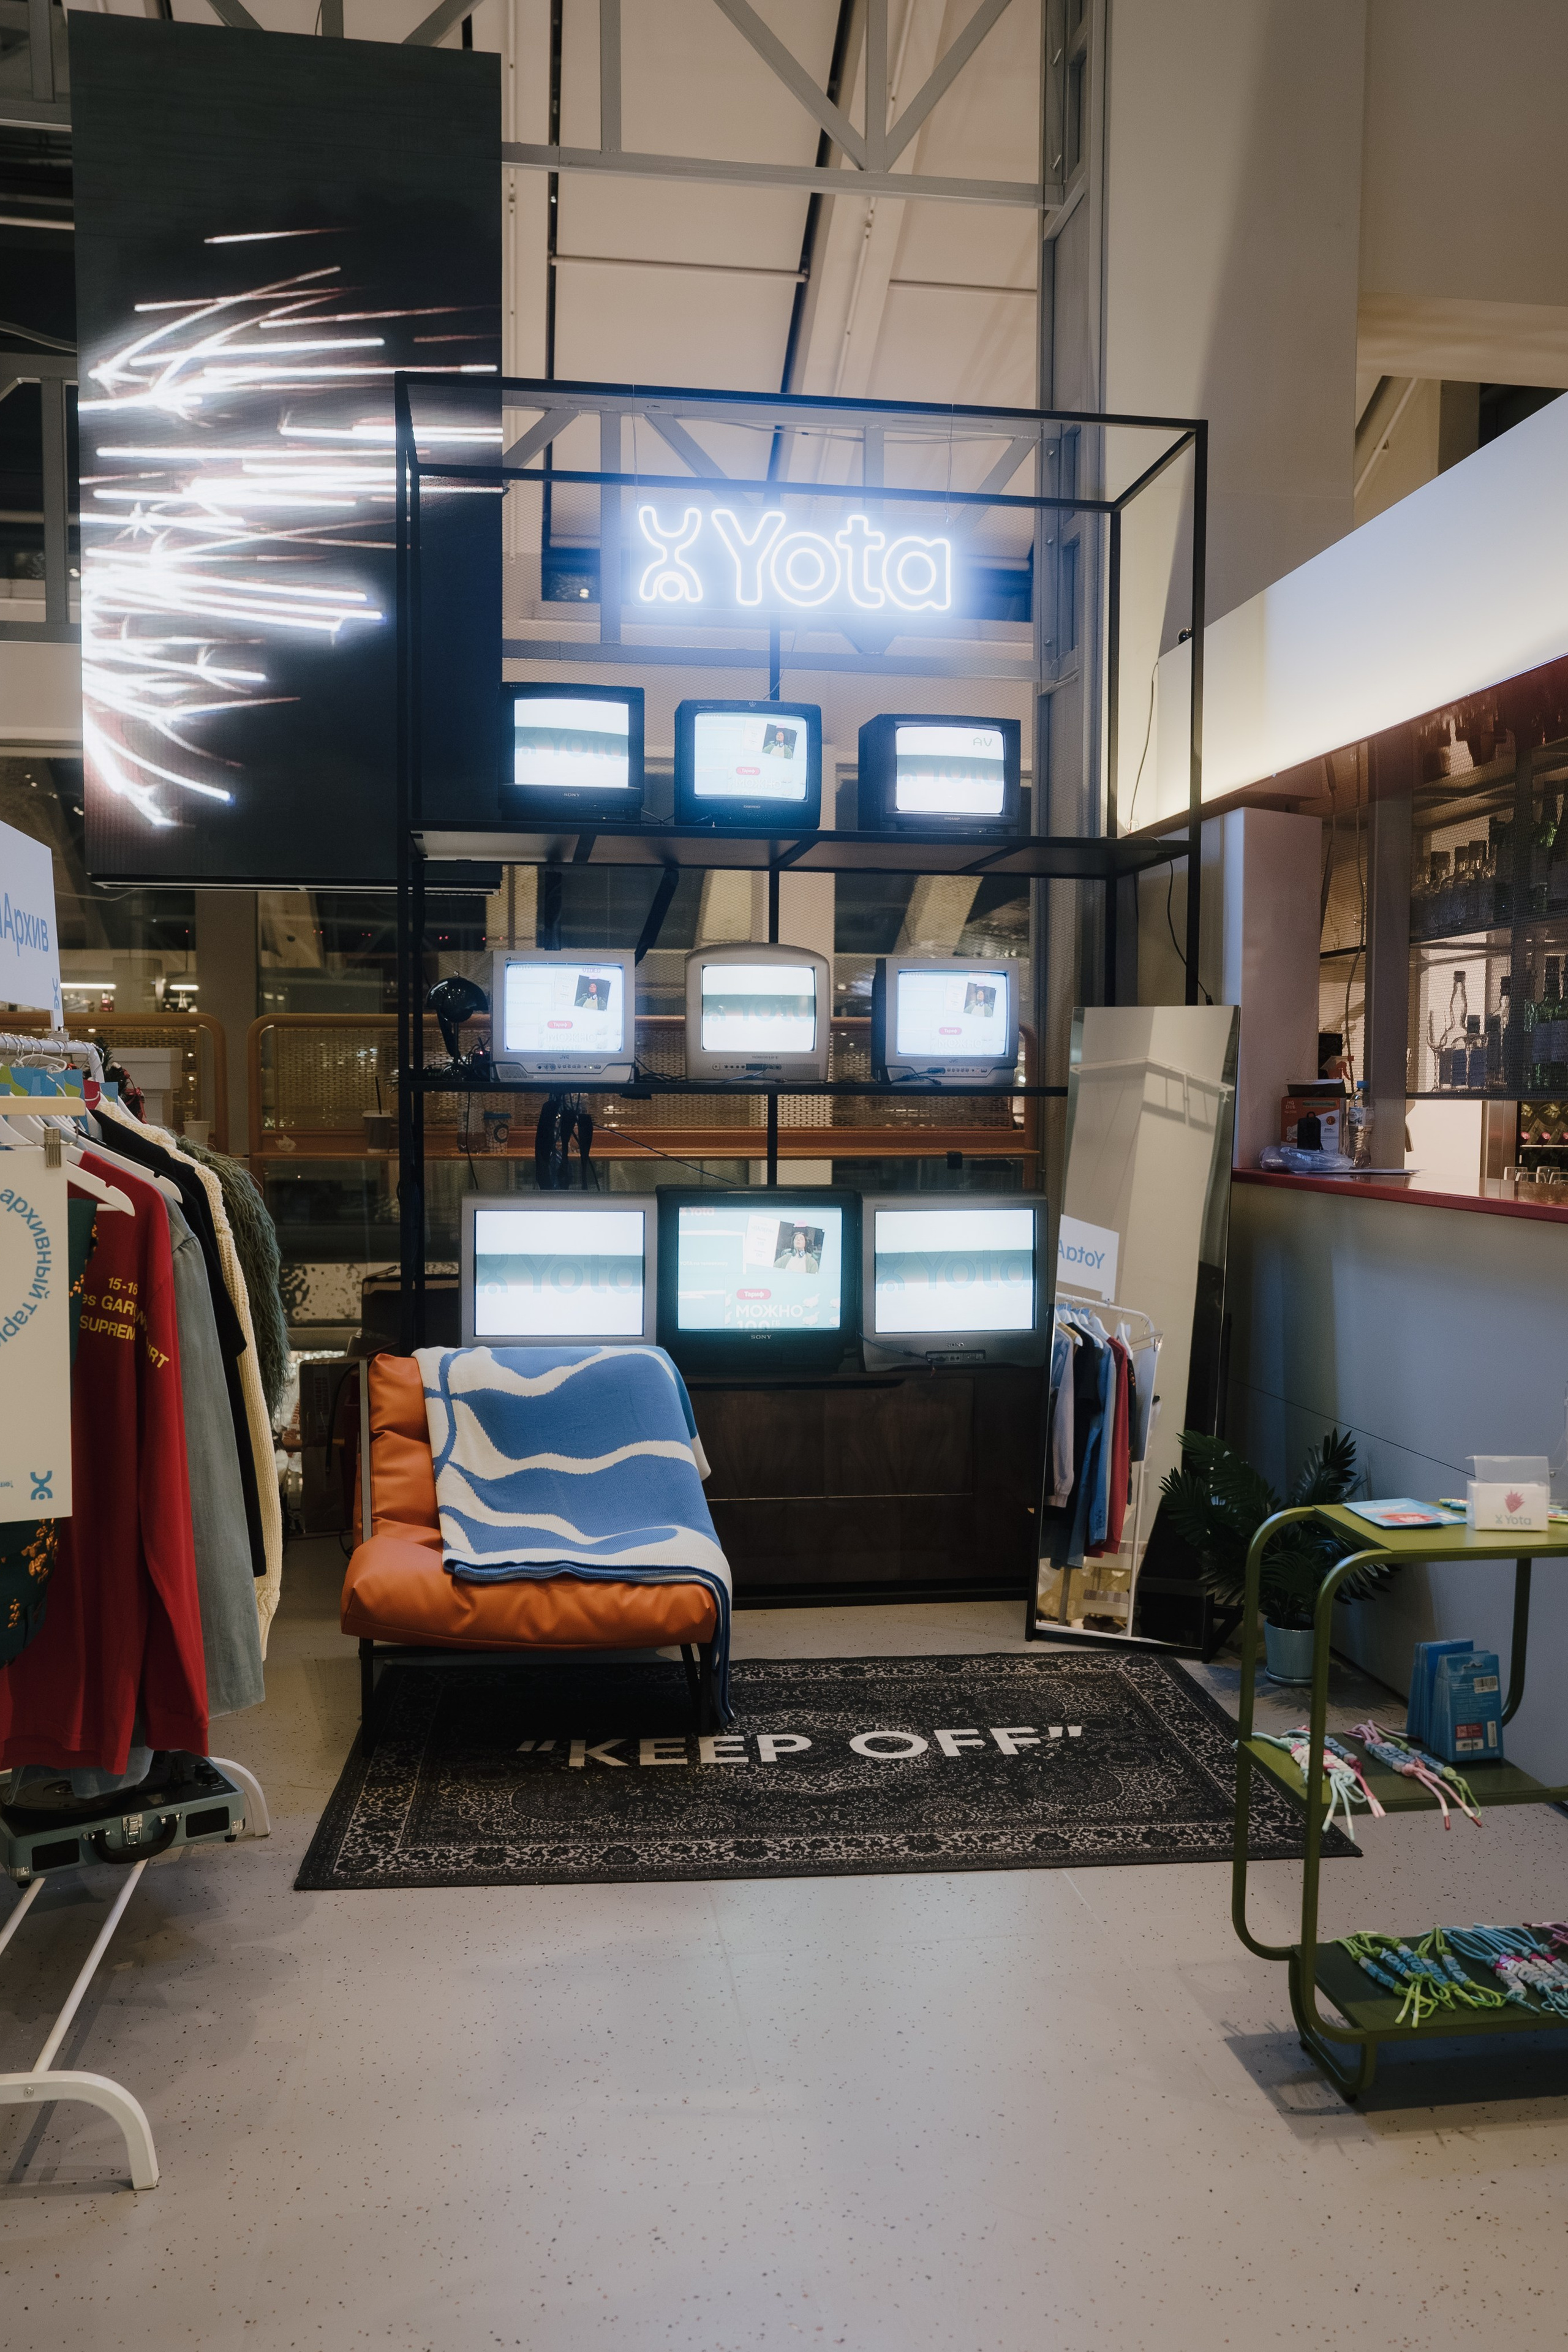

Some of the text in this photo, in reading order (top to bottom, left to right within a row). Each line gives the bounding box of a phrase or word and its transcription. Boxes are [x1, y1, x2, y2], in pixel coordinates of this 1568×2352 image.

[711, 508, 951, 611] Yota
[973, 737, 992, 747] AV
[736, 778, 782, 790] МОЖНО
[0, 892, 48, 956] Архив
[546, 1033, 597, 1043] МОЖНО
[938, 1038, 983, 1049] МОЖНО
[0, 1188, 51, 1299] архивный
[519, 1254, 641, 1294] Yota
[914, 1250, 1033, 1290] Yota
[108, 1277, 138, 1295] 15-16
[736, 1304, 804, 1317] МОЖНО
[80, 1315, 135, 1340] SUPREM
[1505, 1515, 1532, 1526] Yota
